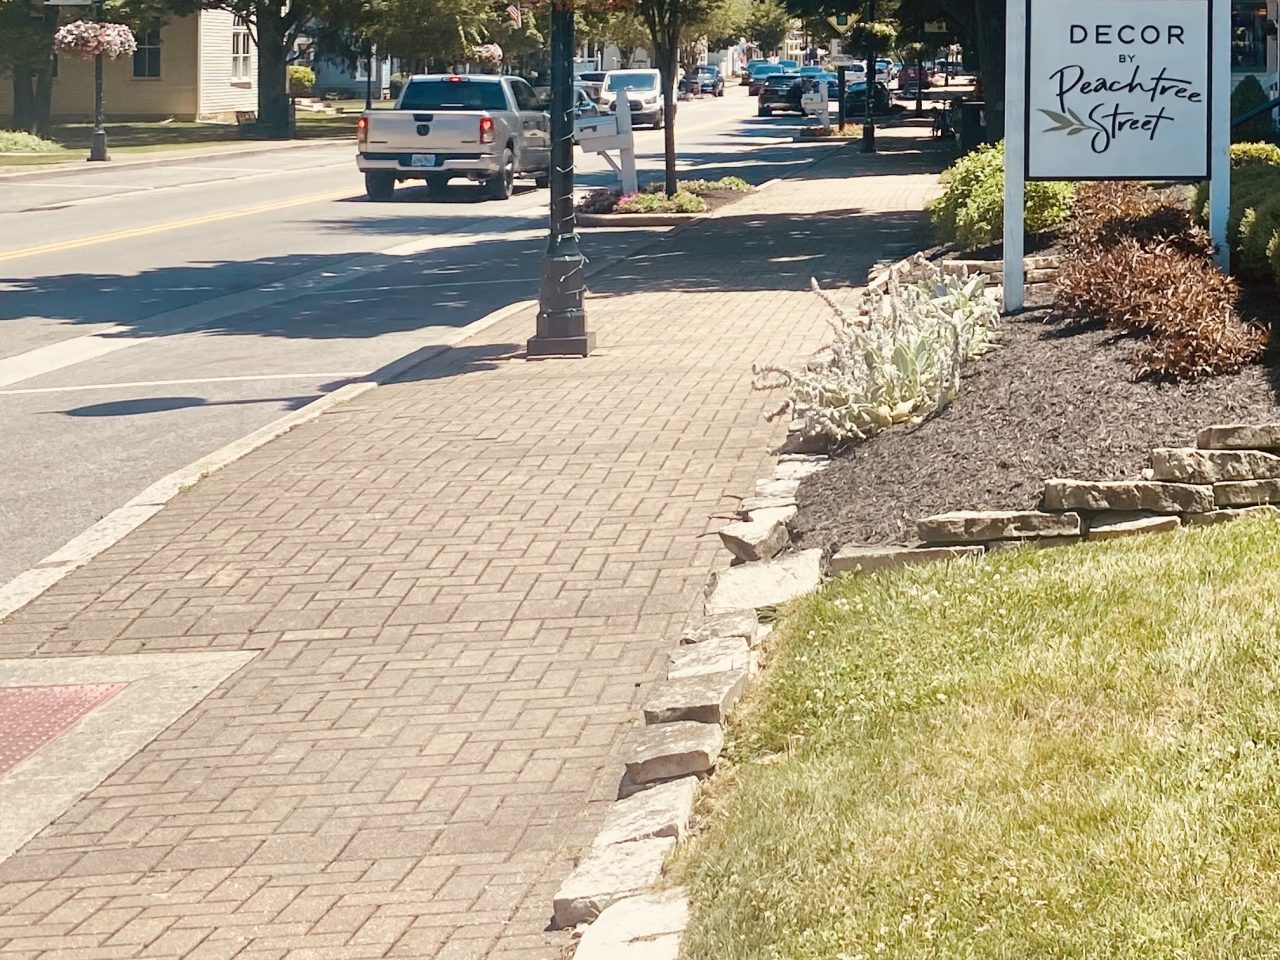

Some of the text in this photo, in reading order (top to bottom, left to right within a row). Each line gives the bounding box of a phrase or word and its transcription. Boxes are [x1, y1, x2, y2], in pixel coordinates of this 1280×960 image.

[1070, 25, 1185, 44] DECOR
[1118, 54, 1136, 63] BY
[1049, 64, 1203, 114] Peachtree
[1088, 103, 1175, 154] Street
